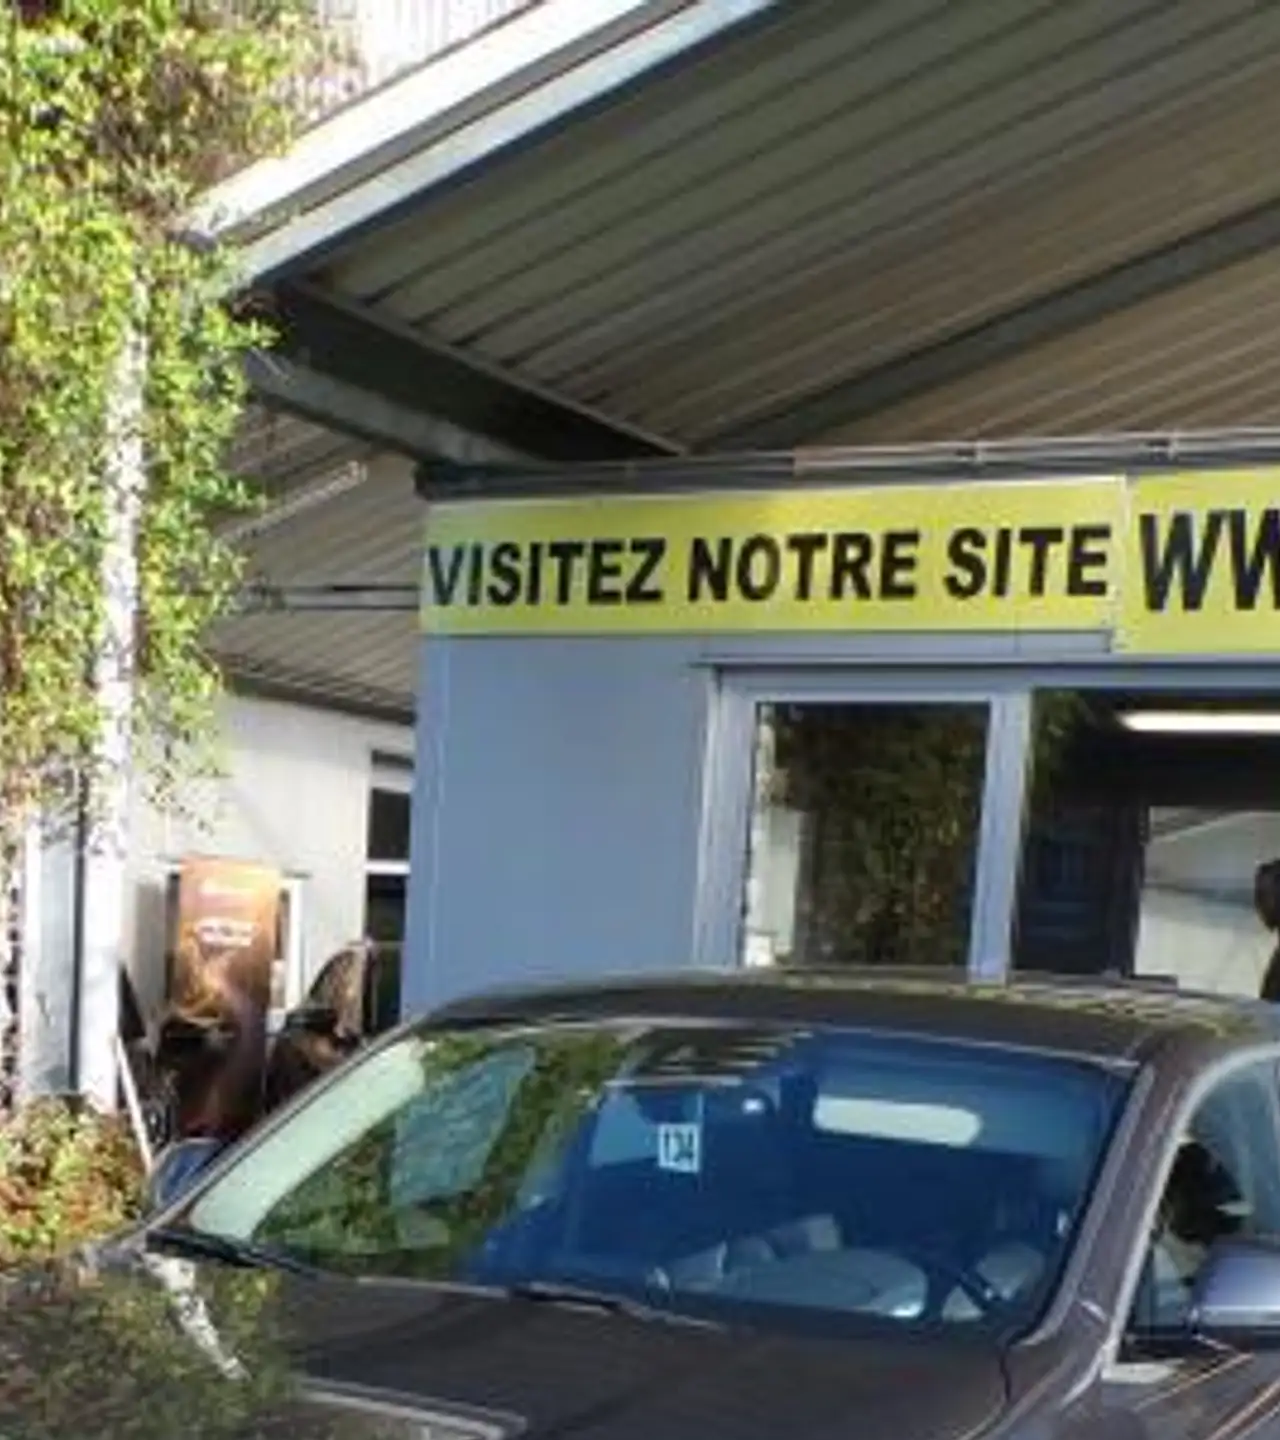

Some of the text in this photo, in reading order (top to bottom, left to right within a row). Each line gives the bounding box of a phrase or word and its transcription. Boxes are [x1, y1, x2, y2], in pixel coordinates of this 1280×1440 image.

[427, 525, 1112, 606] VISITEZ NOTRE SITE
